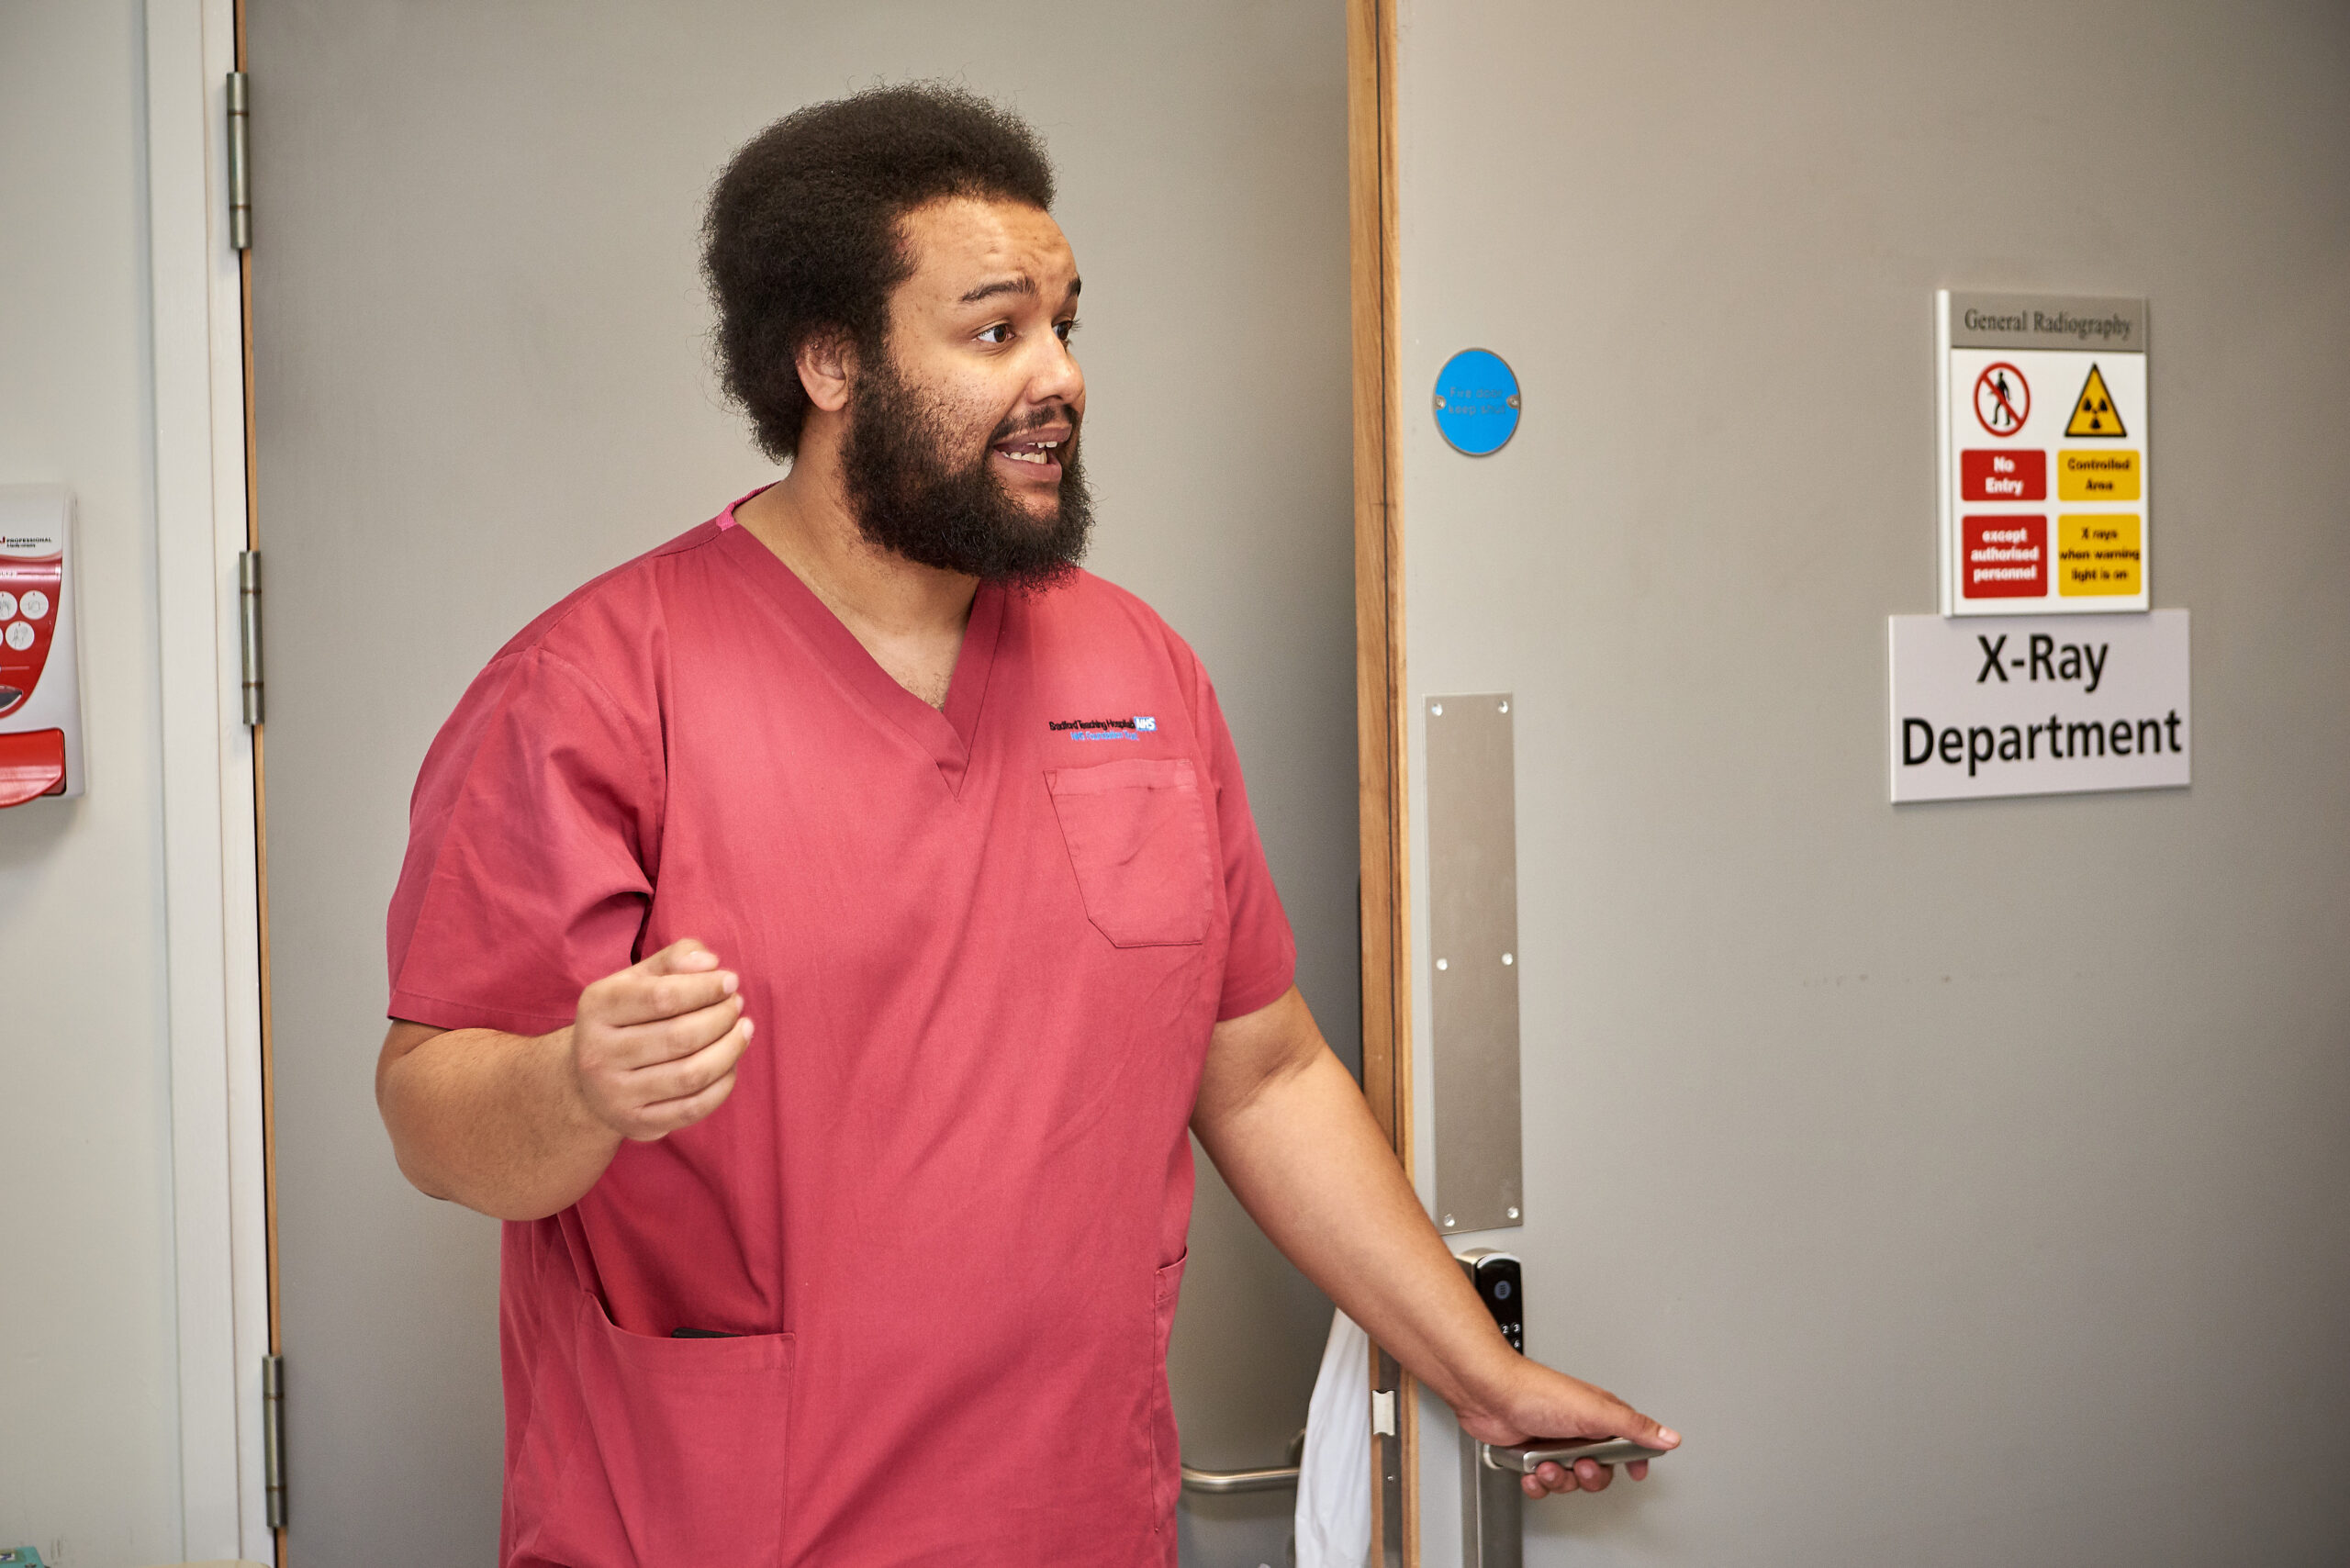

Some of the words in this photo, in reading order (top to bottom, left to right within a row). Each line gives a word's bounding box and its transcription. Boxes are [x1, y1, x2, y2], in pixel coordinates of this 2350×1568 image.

[1964, 308, 2027, 331] General
[2033, 311, 2131, 341] Radiography
[1476, 387, 1503, 398] door
[1449, 404, 1476, 417] keep
[1994, 456, 2015, 473] No
[2067, 458, 2131, 471] Controlled
[1986, 477, 2023, 497] Entry
[2086, 479, 2113, 491] Area
[1982, 528, 2027, 543] except
[2081, 527, 2089, 540] X
[2092, 529, 2118, 541] rays
[1971, 546, 2039, 562] authorised
[2060, 549, 2089, 560] when
[2095, 548, 2140, 561] warning
[1974, 566, 2036, 583] personnel
[2072, 567, 2097, 581] light
[2101, 567, 2109, 580] is
[2113, 570, 2128, 580] on
[1976, 633, 2109, 693] X-Ray
[1049, 720, 1078, 731] Bradford
[1078, 719, 1107, 731] Teaching
[1135, 717, 1156, 730] NHS
[1902, 709, 2181, 777] Department
[1502, 1325, 1509, 1334] 2
